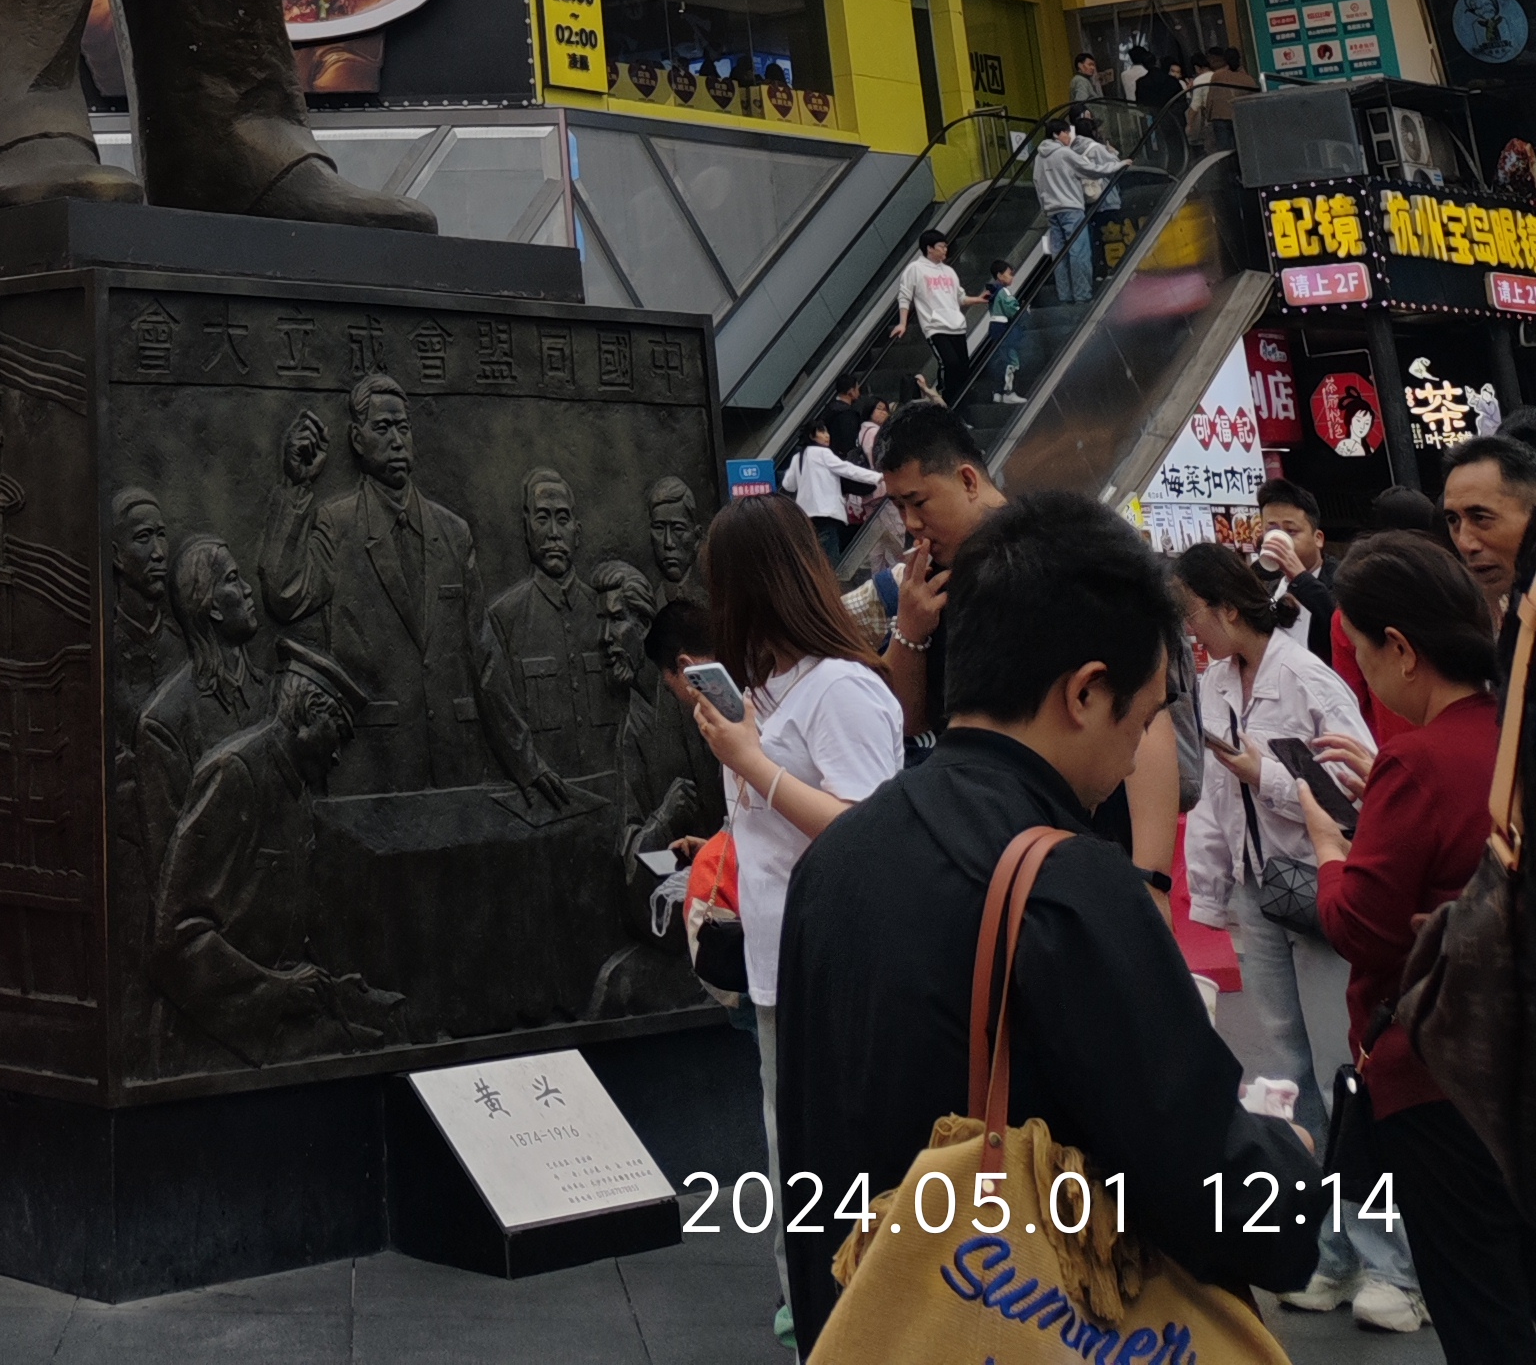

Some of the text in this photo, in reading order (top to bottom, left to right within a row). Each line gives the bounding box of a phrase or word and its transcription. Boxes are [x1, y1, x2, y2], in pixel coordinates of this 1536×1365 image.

[555, 24, 598, 49] 02:00
[1269, 192, 1367, 259] 配镜
[1497, 279, 1536, 305] 请上2
[1410, 380, 1470, 432] 茶
[509, 1124, 580, 1148] 1874-1916
